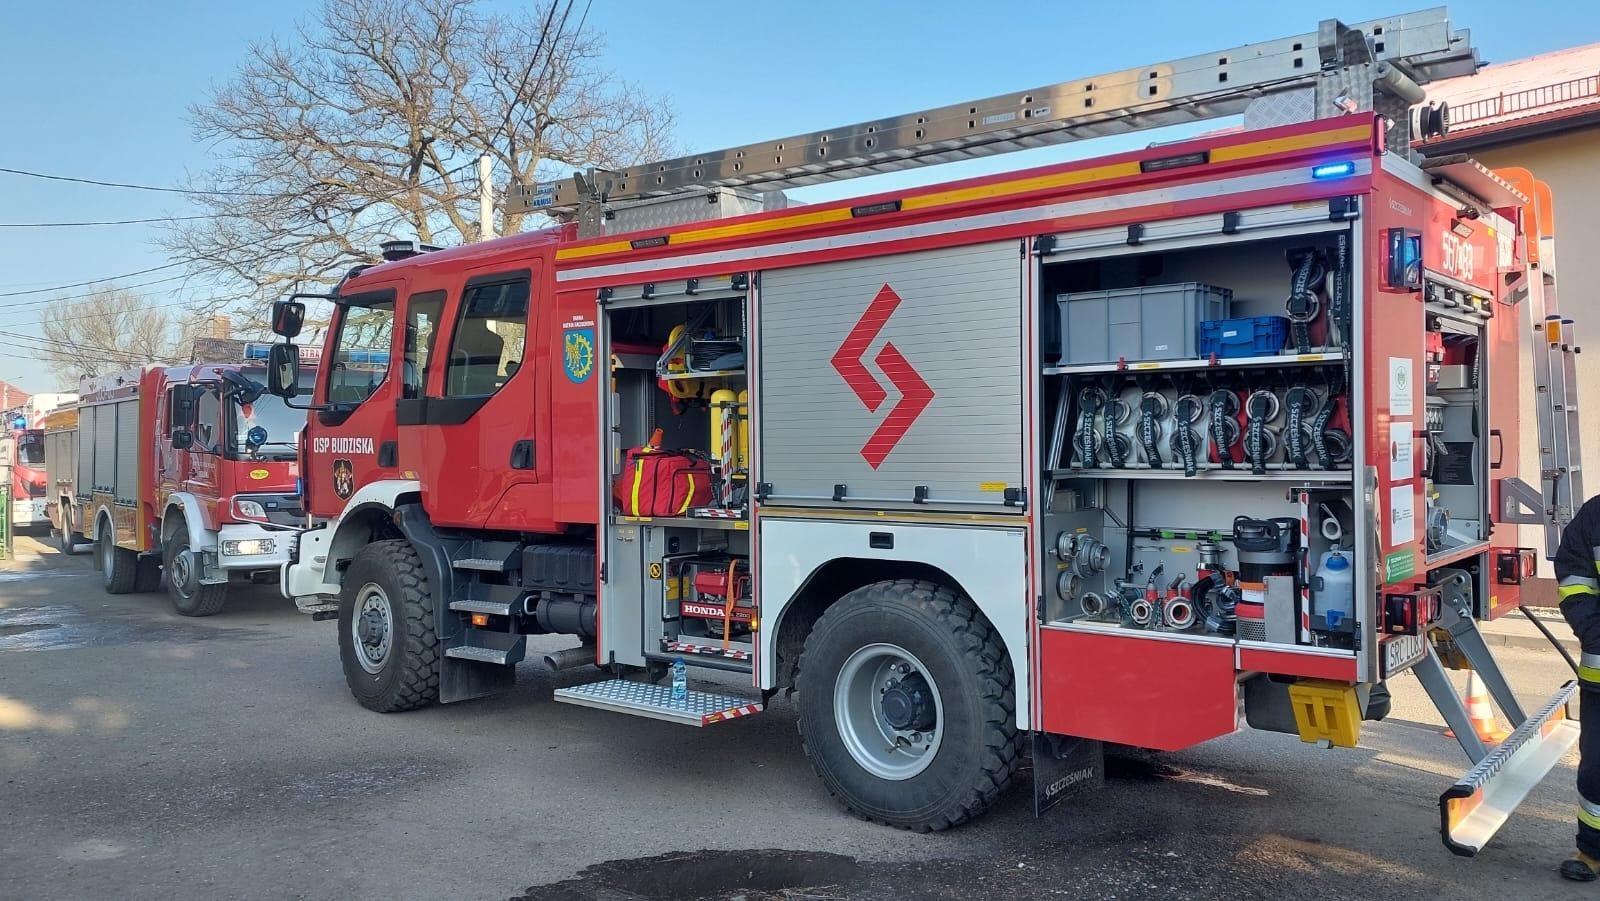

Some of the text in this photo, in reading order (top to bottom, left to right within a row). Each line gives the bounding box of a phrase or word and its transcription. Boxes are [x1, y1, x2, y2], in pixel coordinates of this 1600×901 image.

[300, 349, 320, 358] STRA
[313, 437, 375, 454] OSP BUDZISKA
[684, 604, 726, 617] HONDA
[1390, 638, 1405, 667] SRC
